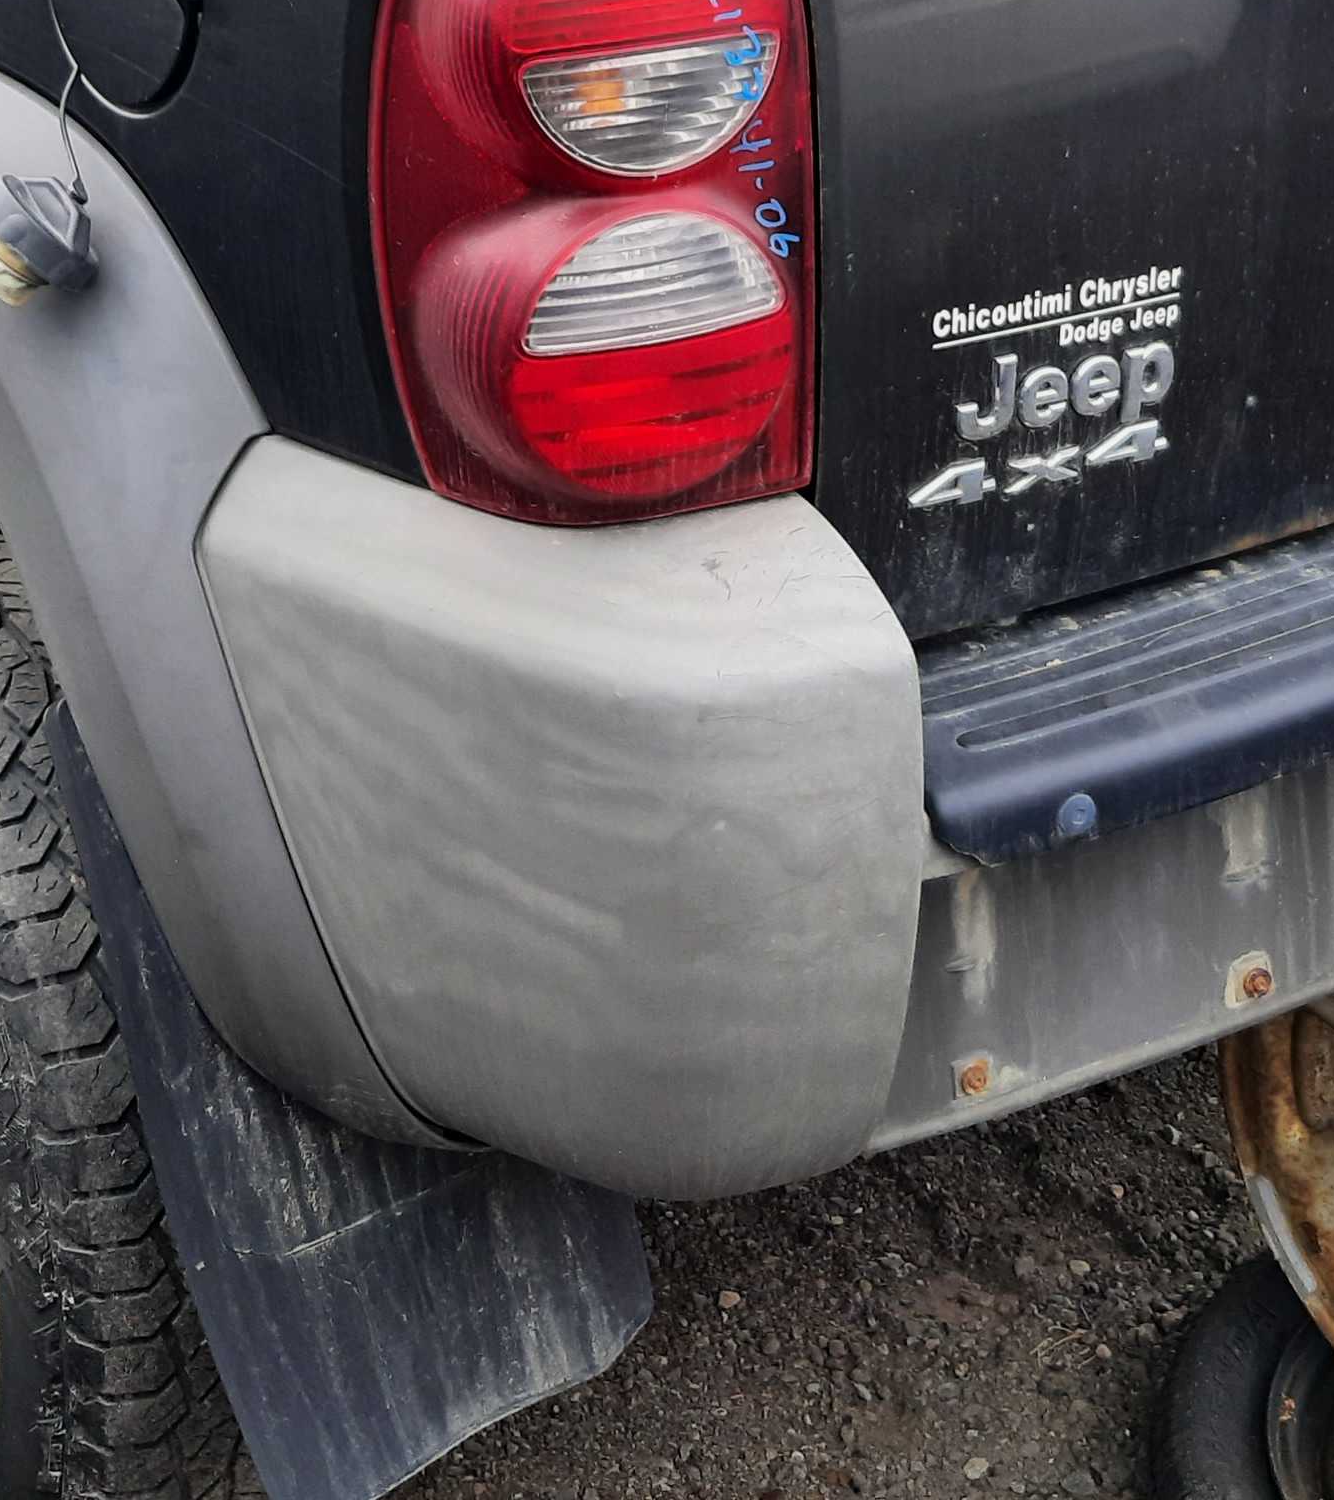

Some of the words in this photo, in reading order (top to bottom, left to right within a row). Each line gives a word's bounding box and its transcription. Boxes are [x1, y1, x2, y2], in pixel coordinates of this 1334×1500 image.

[931, 283, 1072, 338] Chicoutimi
[1079, 266, 1182, 304] Chrysler
[1059, 316, 1124, 347] Dodge
[1129, 303, 1180, 332] Jeep
[955, 341, 1175, 442] Jeep
